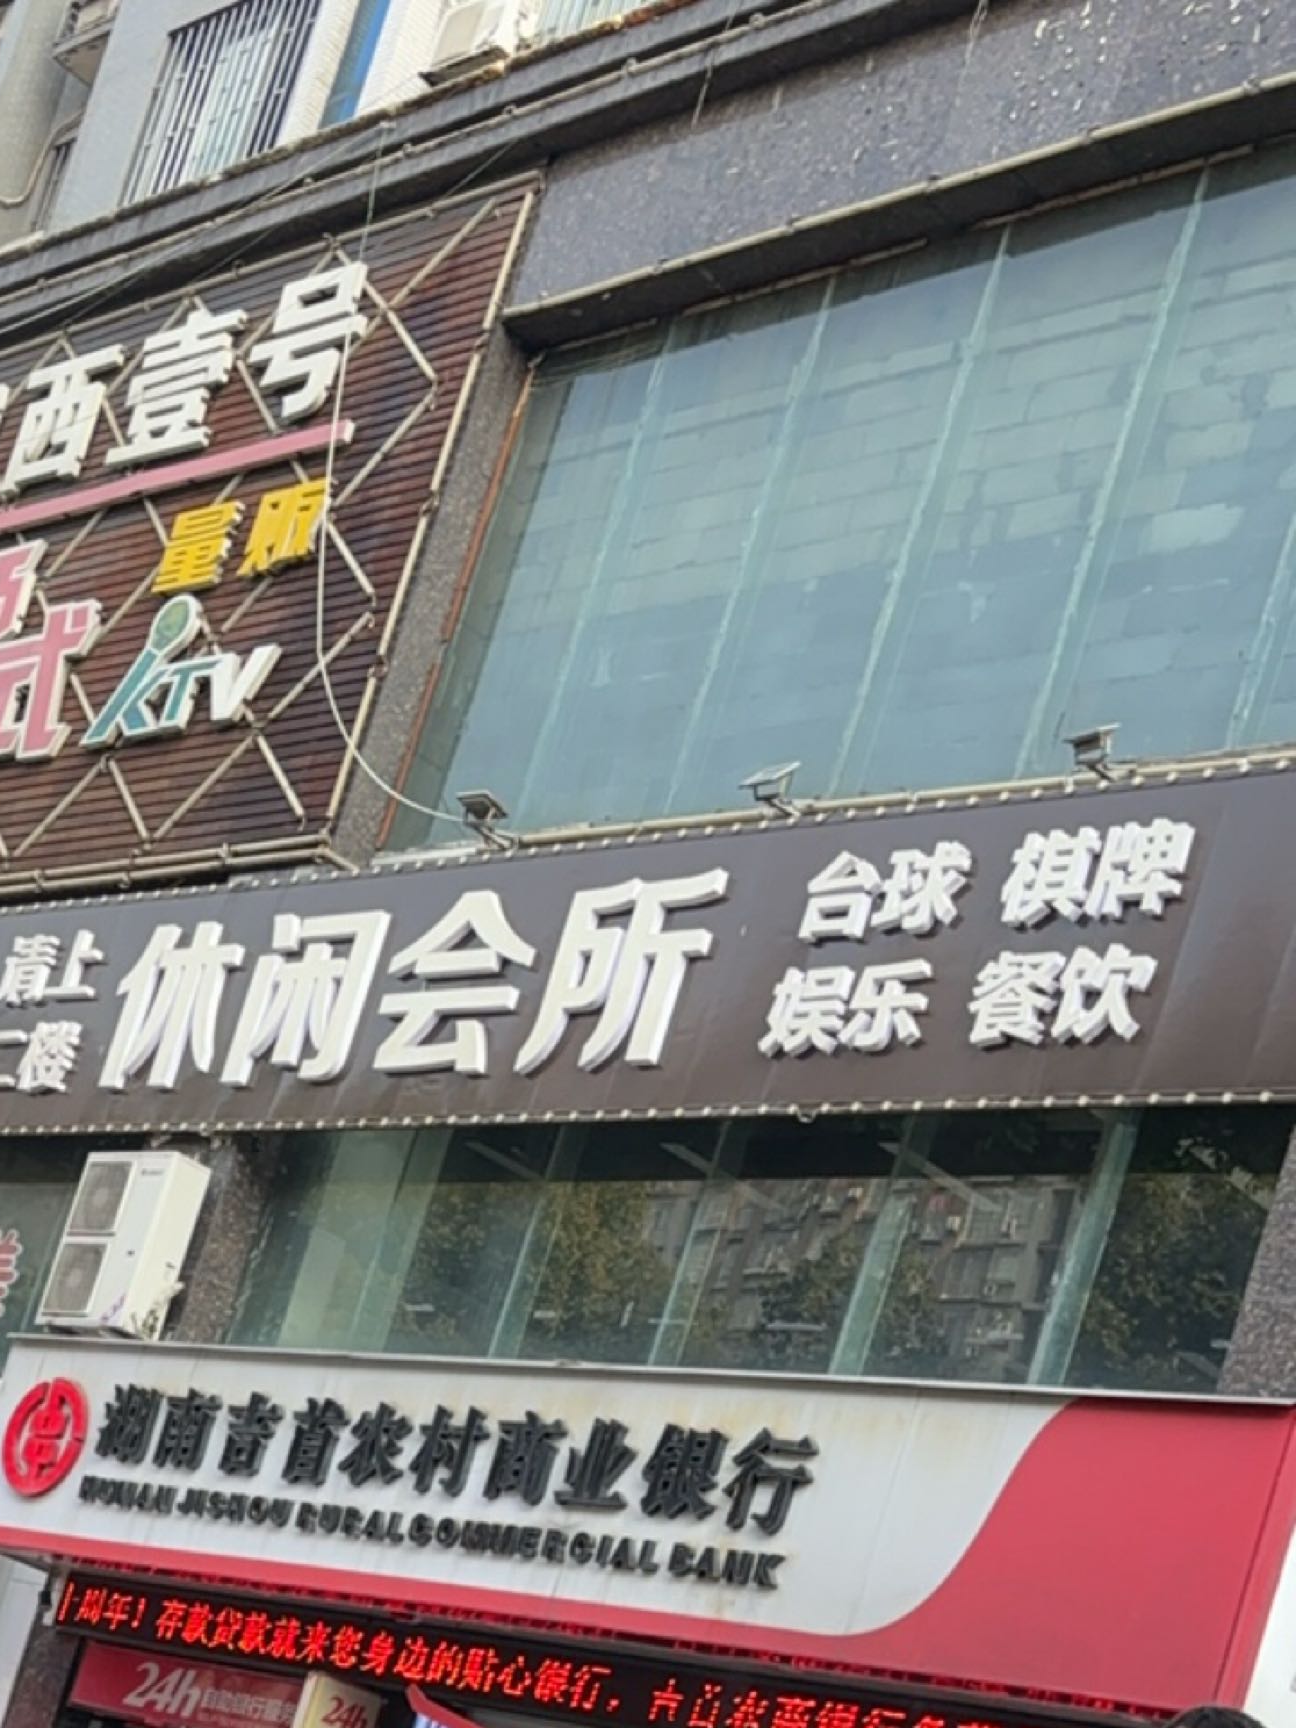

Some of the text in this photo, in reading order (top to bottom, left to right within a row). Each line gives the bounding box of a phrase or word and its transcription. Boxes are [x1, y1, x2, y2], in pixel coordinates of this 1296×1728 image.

[152, 477, 331, 595] 量贩
[81, 596, 283, 748] KTV
[798, 817, 1197, 943] 台球 棋牌
[99, 868, 730, 1091] 休闲会所
[758, 943, 1159, 1058] 娱乐 餐饮
[94, 1382, 820, 1535] 湖南吉首农村商业银行
[78, 1474, 787, 1590] HUNAN JISHOU RURAL COMMERCIAL BANK
[122, 1661, 203, 1718] 24h
